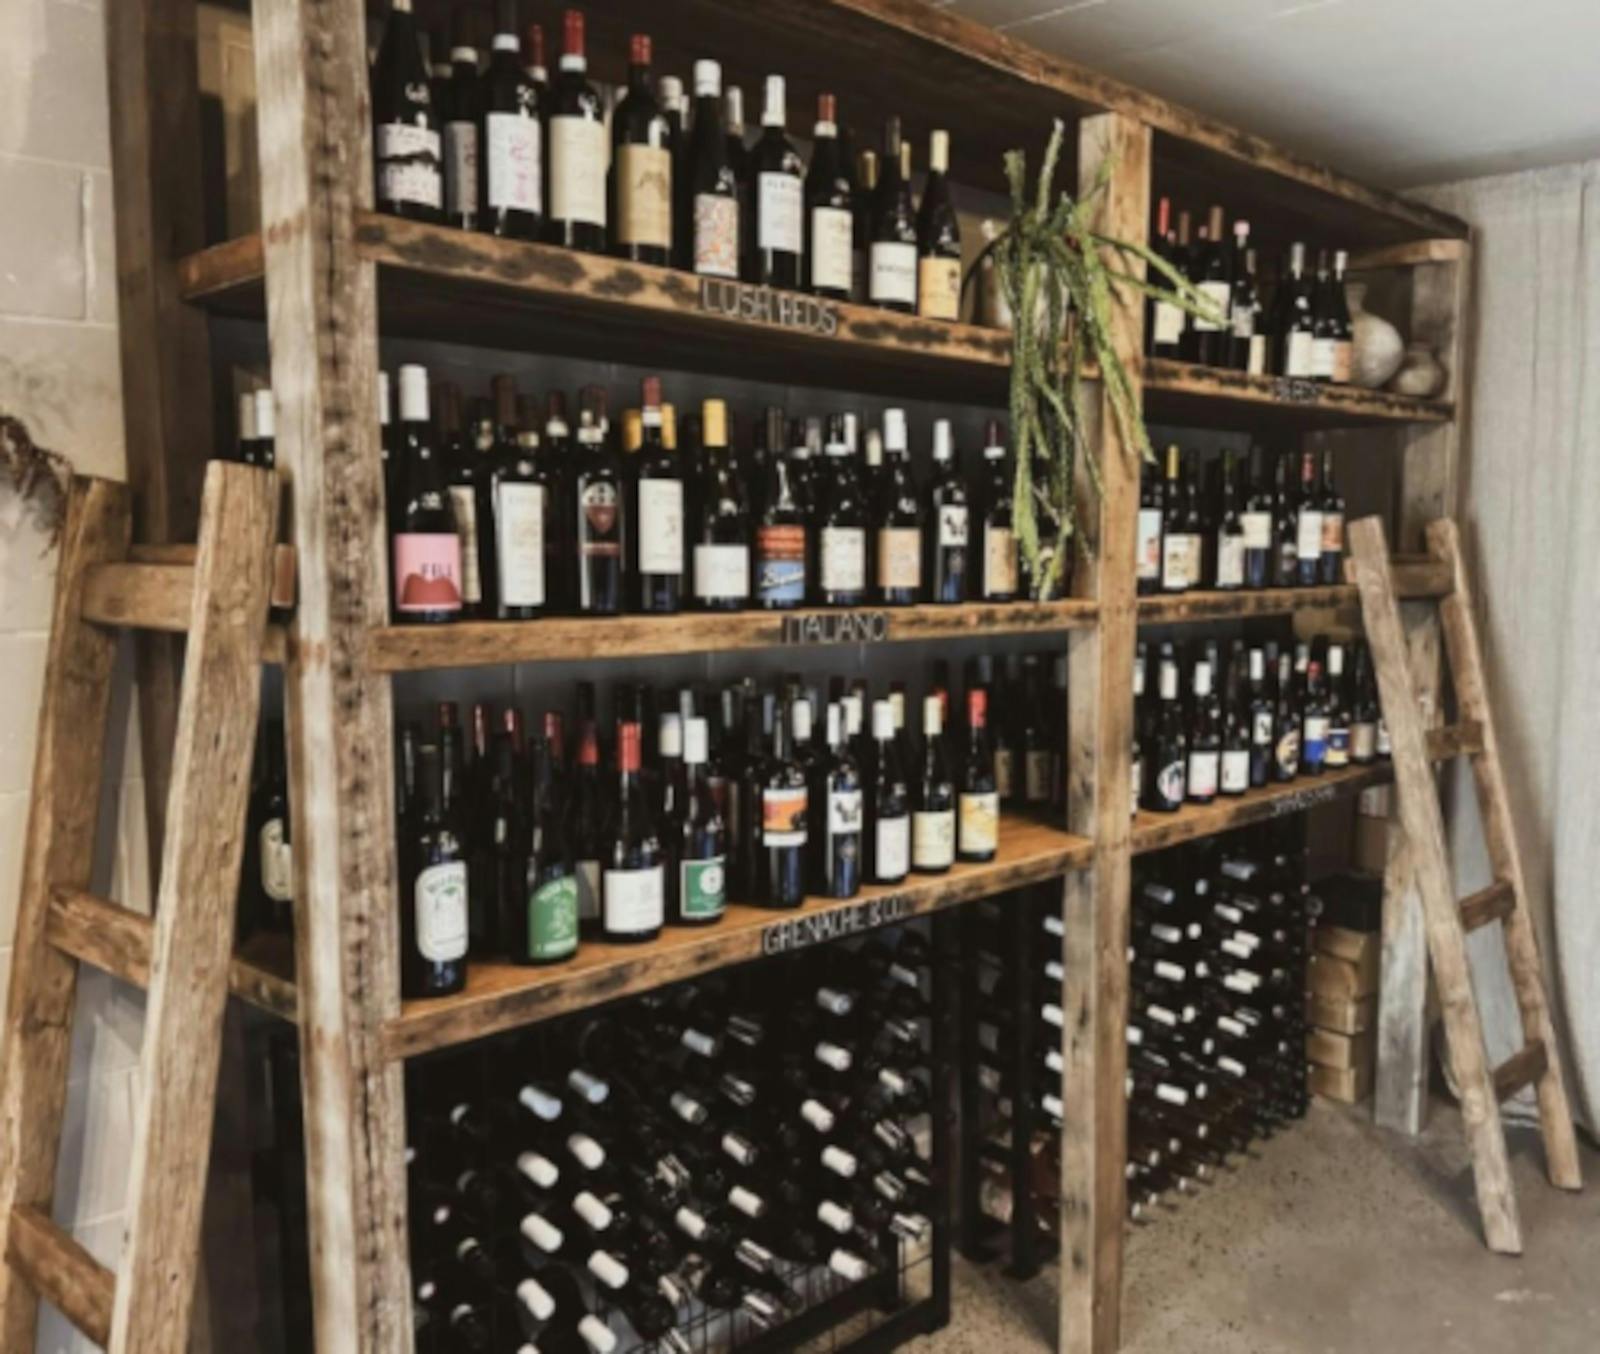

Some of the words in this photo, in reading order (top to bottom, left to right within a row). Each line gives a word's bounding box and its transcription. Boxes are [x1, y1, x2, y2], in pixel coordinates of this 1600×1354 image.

[703, 280, 773, 324] LUSH
[779, 291, 837, 337] REDS
[786, 613, 888, 645] ITALIANO
[764, 903, 866, 955] GRENACHE
